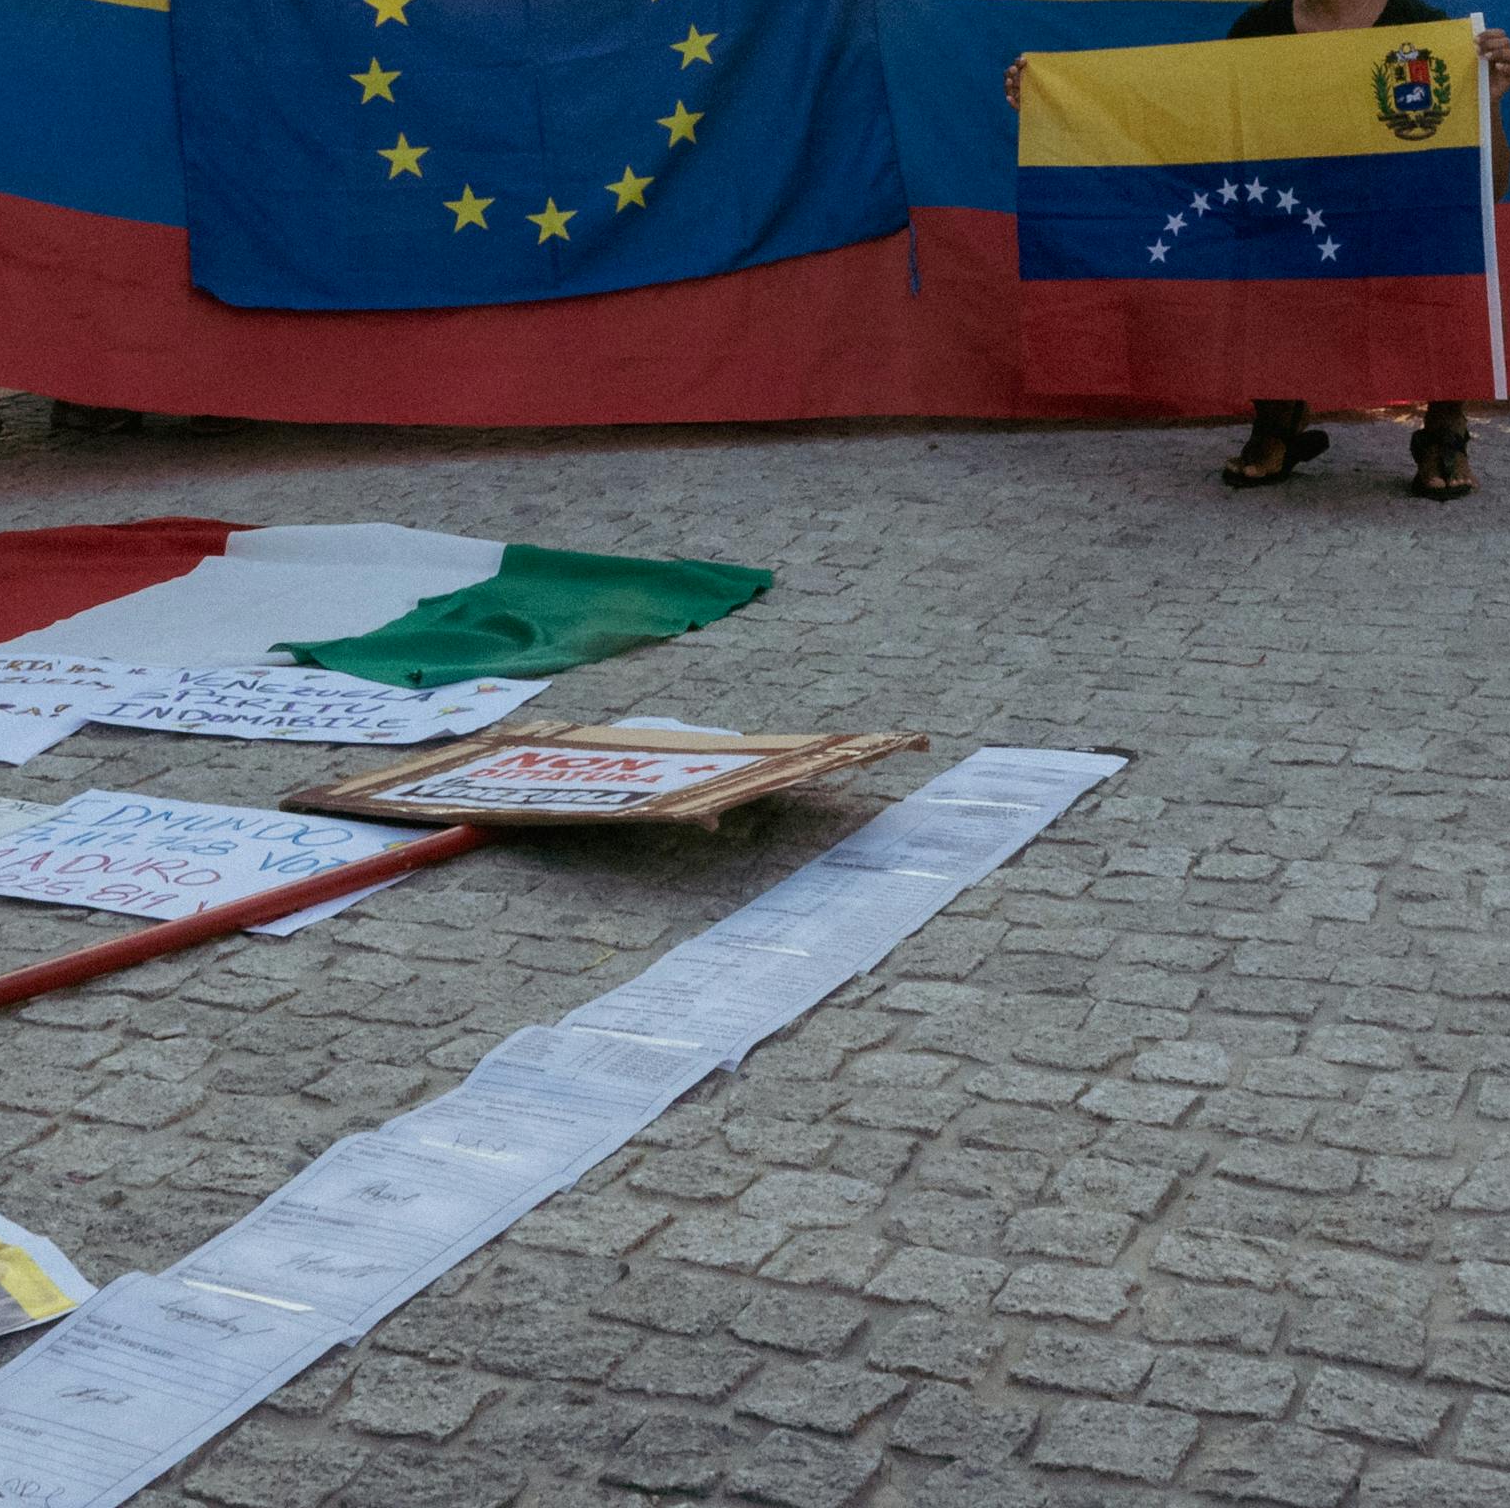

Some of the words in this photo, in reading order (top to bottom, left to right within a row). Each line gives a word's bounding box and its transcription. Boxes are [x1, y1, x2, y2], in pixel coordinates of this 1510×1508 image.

[179, 671, 437, 702] VENEZUELA
[93, 702, 411, 730] INDOMABILE
[493, 752, 669, 771] NON
[466, 768, 663, 784] DITTATURA
[415, 784, 627, 804] VENEZUELA
